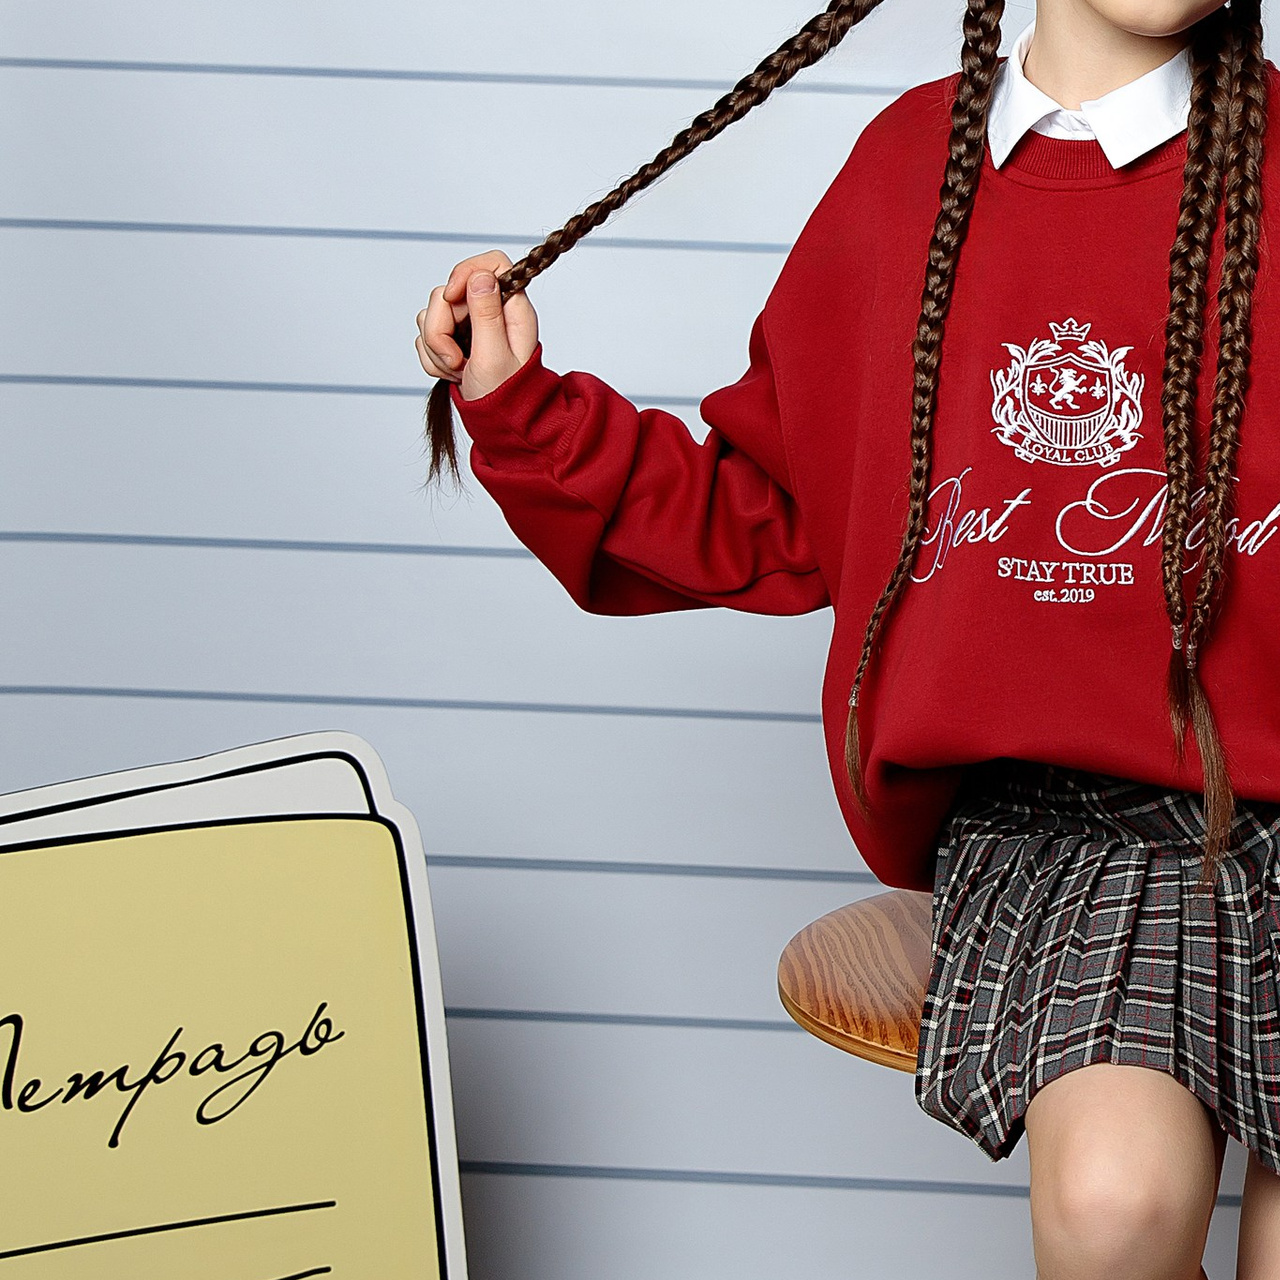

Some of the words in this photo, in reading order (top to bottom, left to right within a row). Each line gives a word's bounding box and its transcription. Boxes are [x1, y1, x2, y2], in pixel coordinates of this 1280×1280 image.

[1020, 436, 1072, 462] ROYAL
[1074, 442, 1115, 462] CLUB
[997, 556, 1061, 583] STAY
[1061, 561, 1135, 586] TRUE
